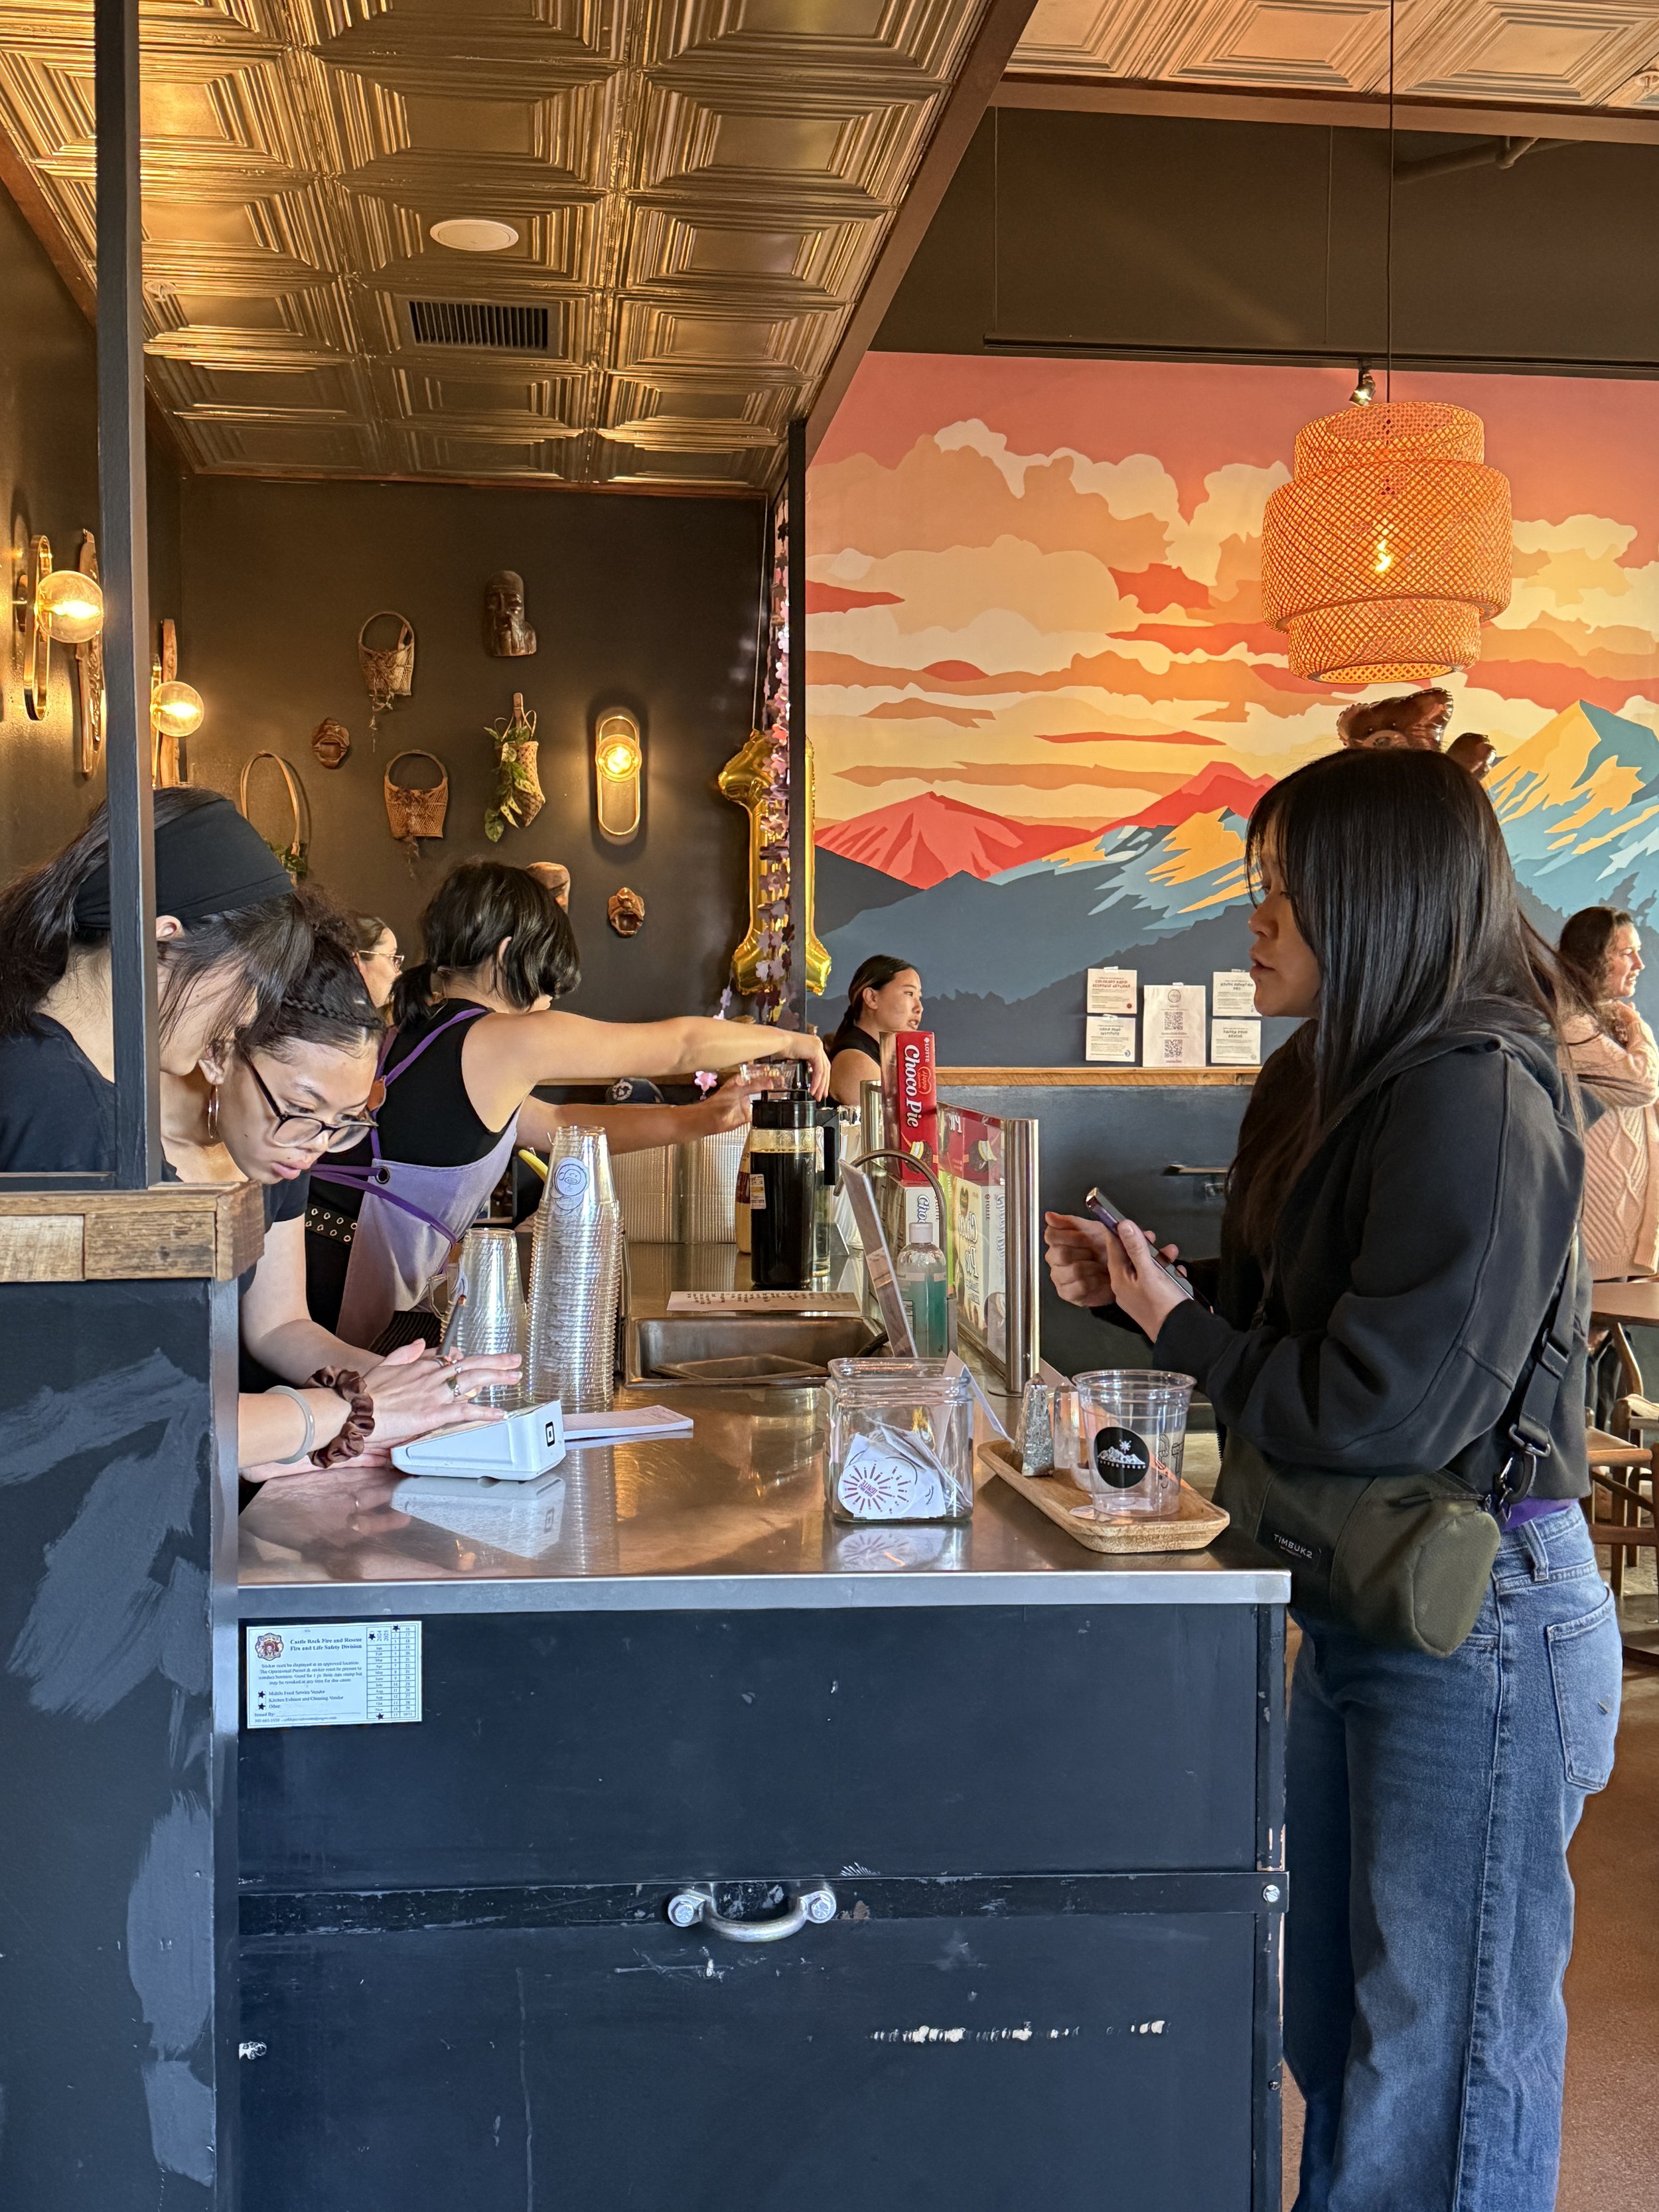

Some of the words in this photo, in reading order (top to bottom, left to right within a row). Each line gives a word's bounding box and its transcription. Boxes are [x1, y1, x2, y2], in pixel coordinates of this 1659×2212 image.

[904, 1045, 920, 1096] Choco
[906, 1097, 922, 1128] Pie
[1274, 1533, 1313, 1559] TIMBUK2
